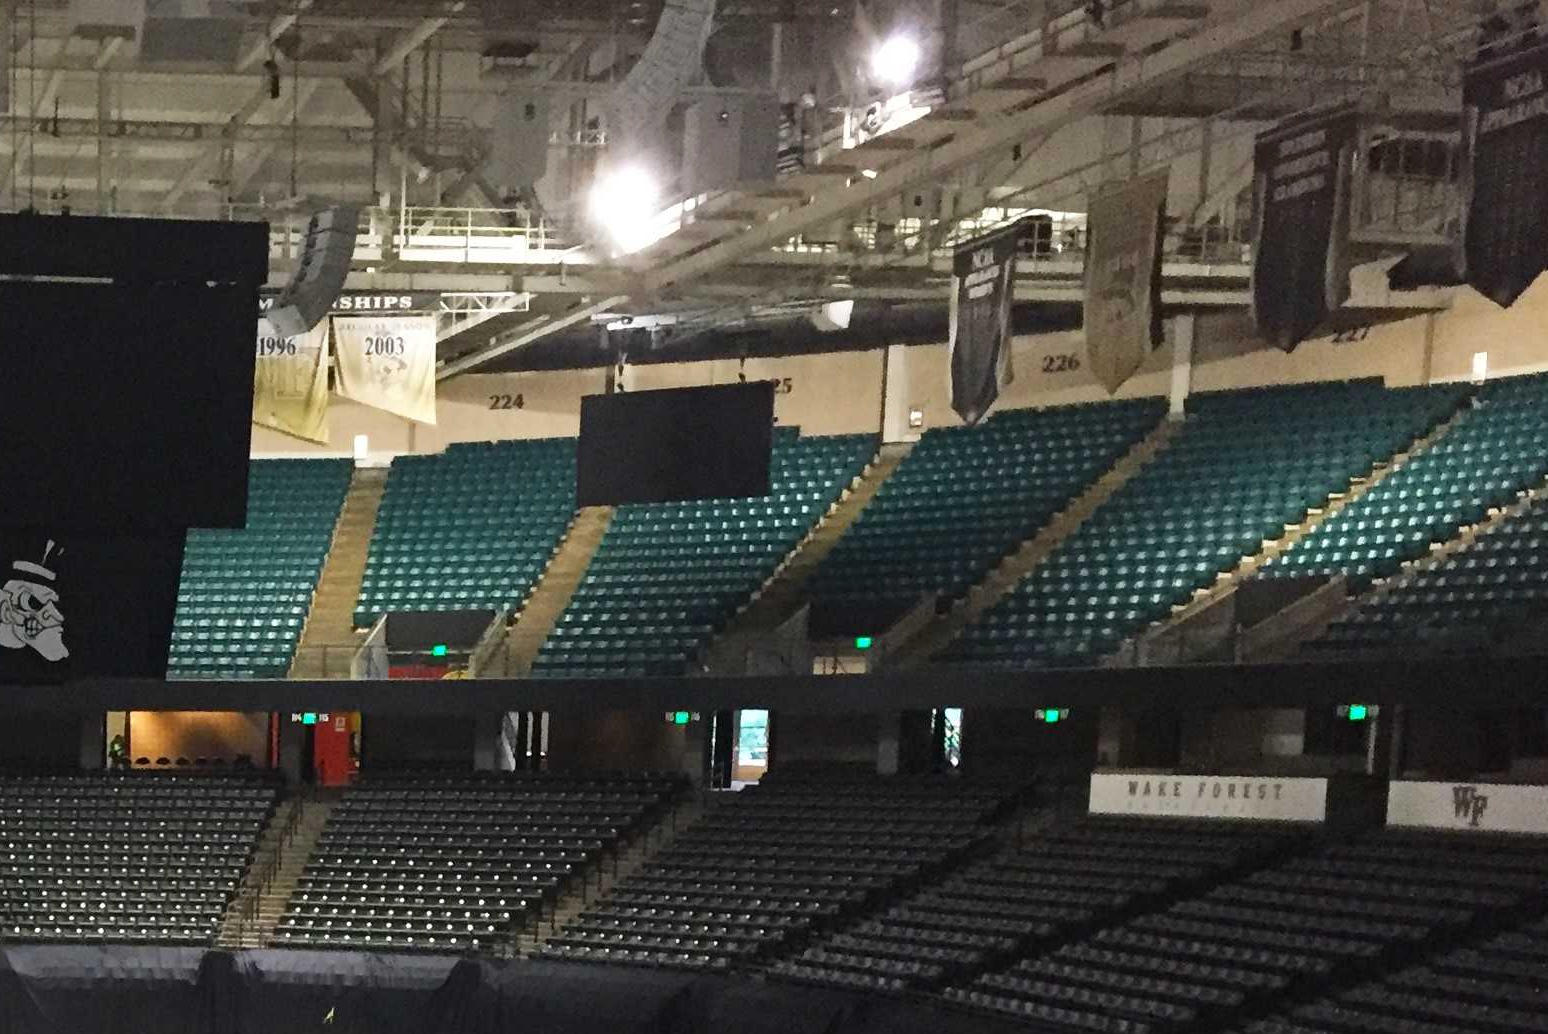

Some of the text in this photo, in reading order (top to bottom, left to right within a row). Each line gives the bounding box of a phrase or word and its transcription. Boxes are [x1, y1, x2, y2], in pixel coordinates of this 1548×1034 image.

[258, 335, 297, 356] 1996
[364, 335, 405, 356] 2003
[1042, 354, 1081, 373] 226
[488, 393, 525, 410] 224
[1128, 780, 1283, 801] WAKE FOREST
[1451, 785, 1489, 827] WF
